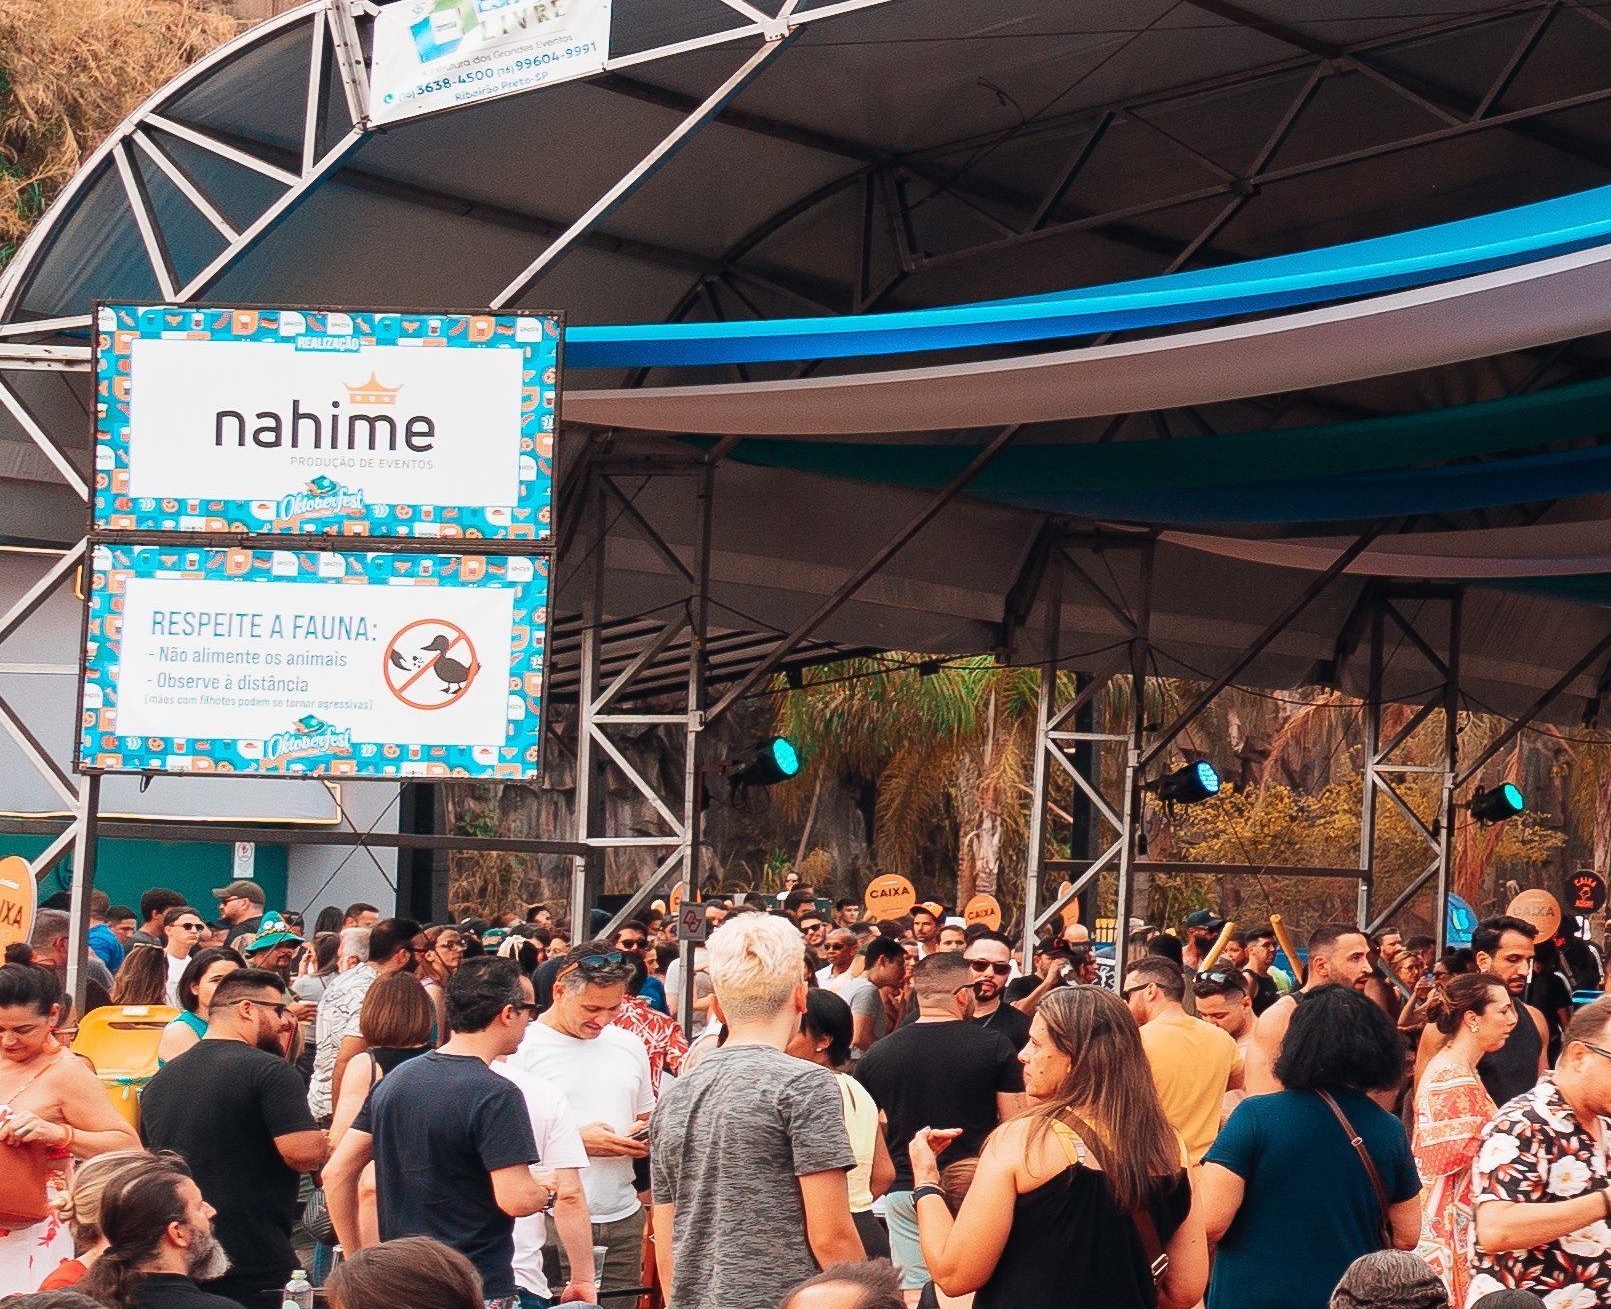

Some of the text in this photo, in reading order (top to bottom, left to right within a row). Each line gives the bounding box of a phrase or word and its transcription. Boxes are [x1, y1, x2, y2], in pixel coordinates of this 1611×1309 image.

[473, 53, 492, 68] dos
[493, 43, 534, 61] Grandes
[535, 34, 574, 50] Eventos
[416, 68, 494, 96] 3638-4500
[454, 83, 500, 102] Ribeirão
[296, 335, 360, 352] REALIZAÇÃO
[214, 399, 436, 453] nahime
[290, 455, 434, 471] PRODUÇÃO DE EVENTOS
[280, 486, 365, 521] Oktoberfest
[151, 610, 378, 642] RESPEITE A FAUNA:
[158, 645, 188, 663] Não
[191, 647, 261, 665] alimente
[264, 651, 283, 666] os
[286, 649, 349, 668] animais
[157, 672, 221, 690] Observe
[236, 674, 310, 693] distância
[176, 695, 198, 706] com
[199, 693, 236, 707] filhotes
[237, 695, 271, 710] podem
[272, 698, 284, 708] se
[285, 696, 315, 709] tornar
[267, 725, 352, 761] Oktoberfest
[869, 885, 911, 900] CAIXA
[967, 907, 997, 921] CAIXA
